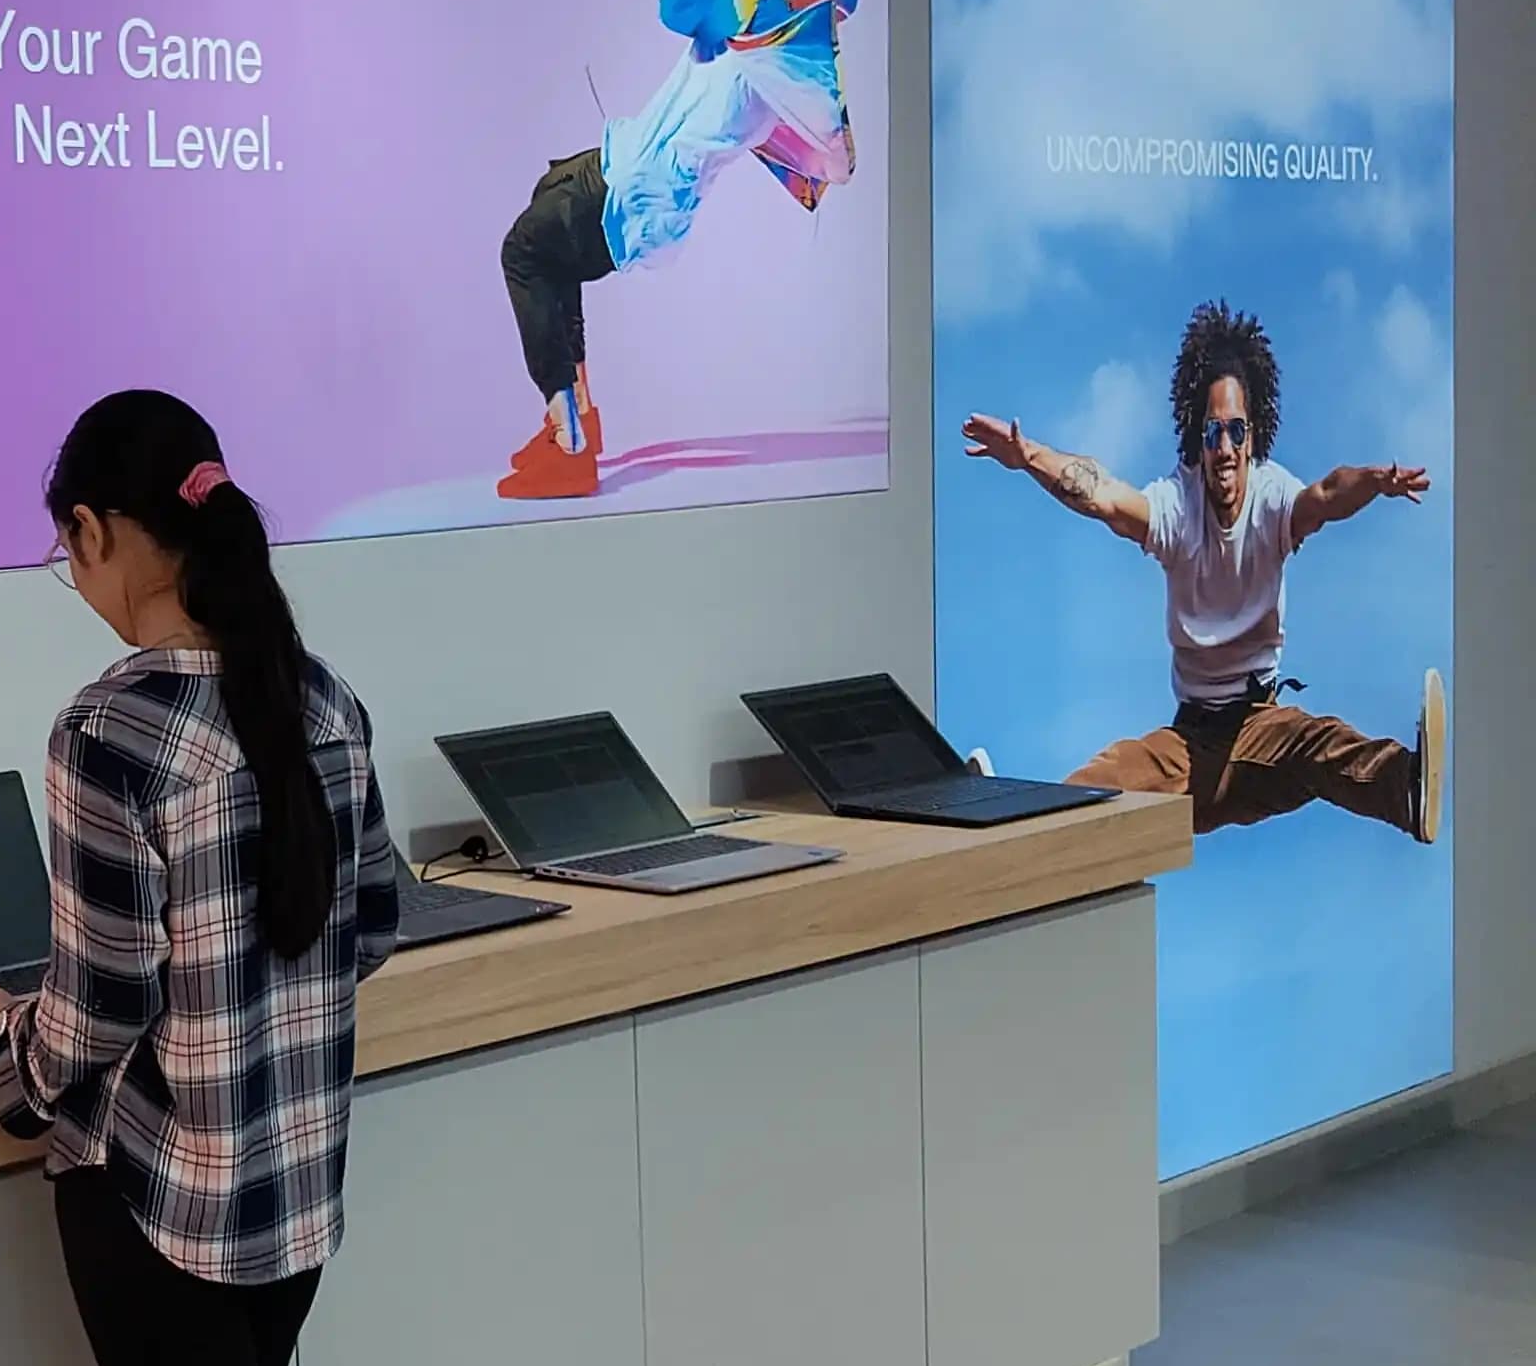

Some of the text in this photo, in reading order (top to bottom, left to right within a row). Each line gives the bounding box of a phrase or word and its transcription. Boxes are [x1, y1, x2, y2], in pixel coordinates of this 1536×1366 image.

[118, 17, 263, 83] Game
[14, 103, 131, 168] Next
[148, 109, 284, 172] Level.
[1046, 135, 1379, 182] UNCOMPROMISING QUALITY.
